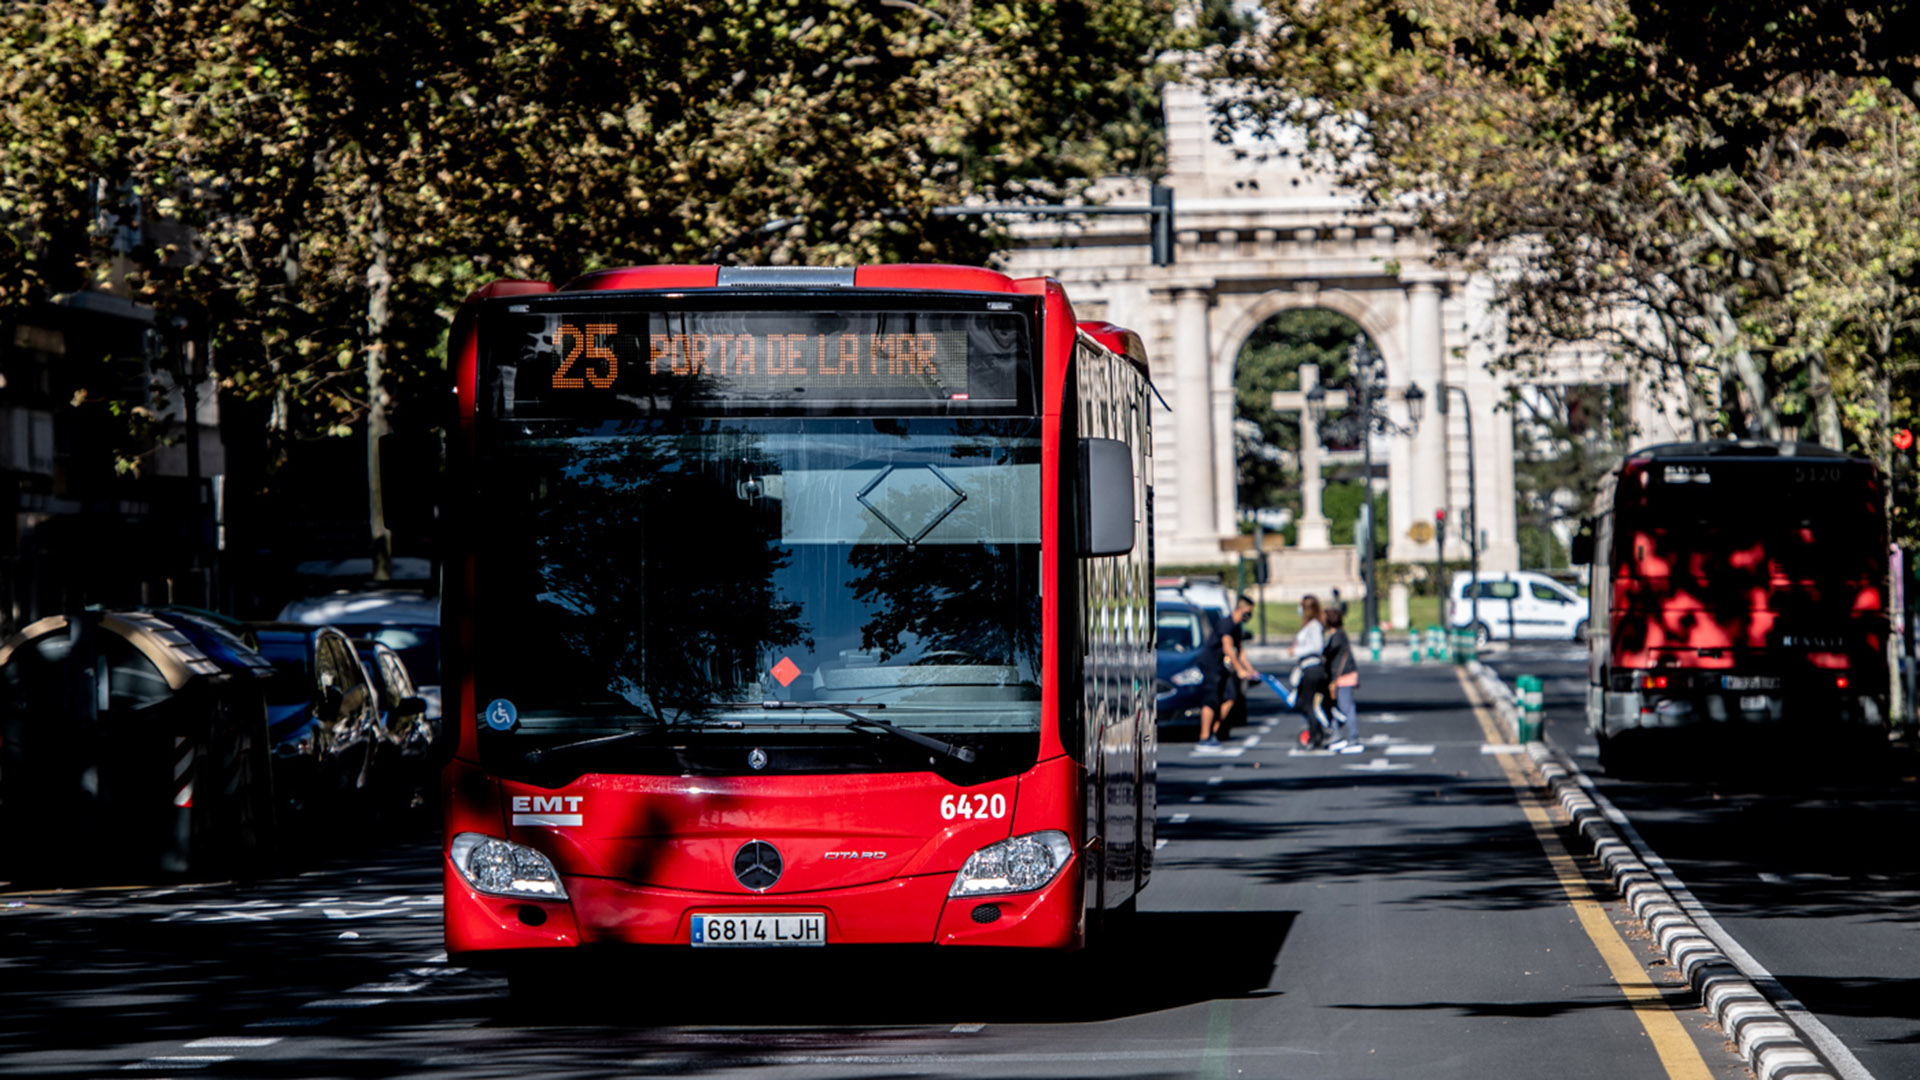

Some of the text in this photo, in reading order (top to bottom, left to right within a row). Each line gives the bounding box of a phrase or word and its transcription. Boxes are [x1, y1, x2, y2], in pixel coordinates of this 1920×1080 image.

[552, 323, 937, 389] 25 PORTA DE LA MAR
[512, 796, 583, 812] EMT
[940, 793, 1007, 820] 6420
[824, 851, 887, 860] CITARO
[708, 919, 767, 940] 6814
[775, 919, 819, 940] LJH
